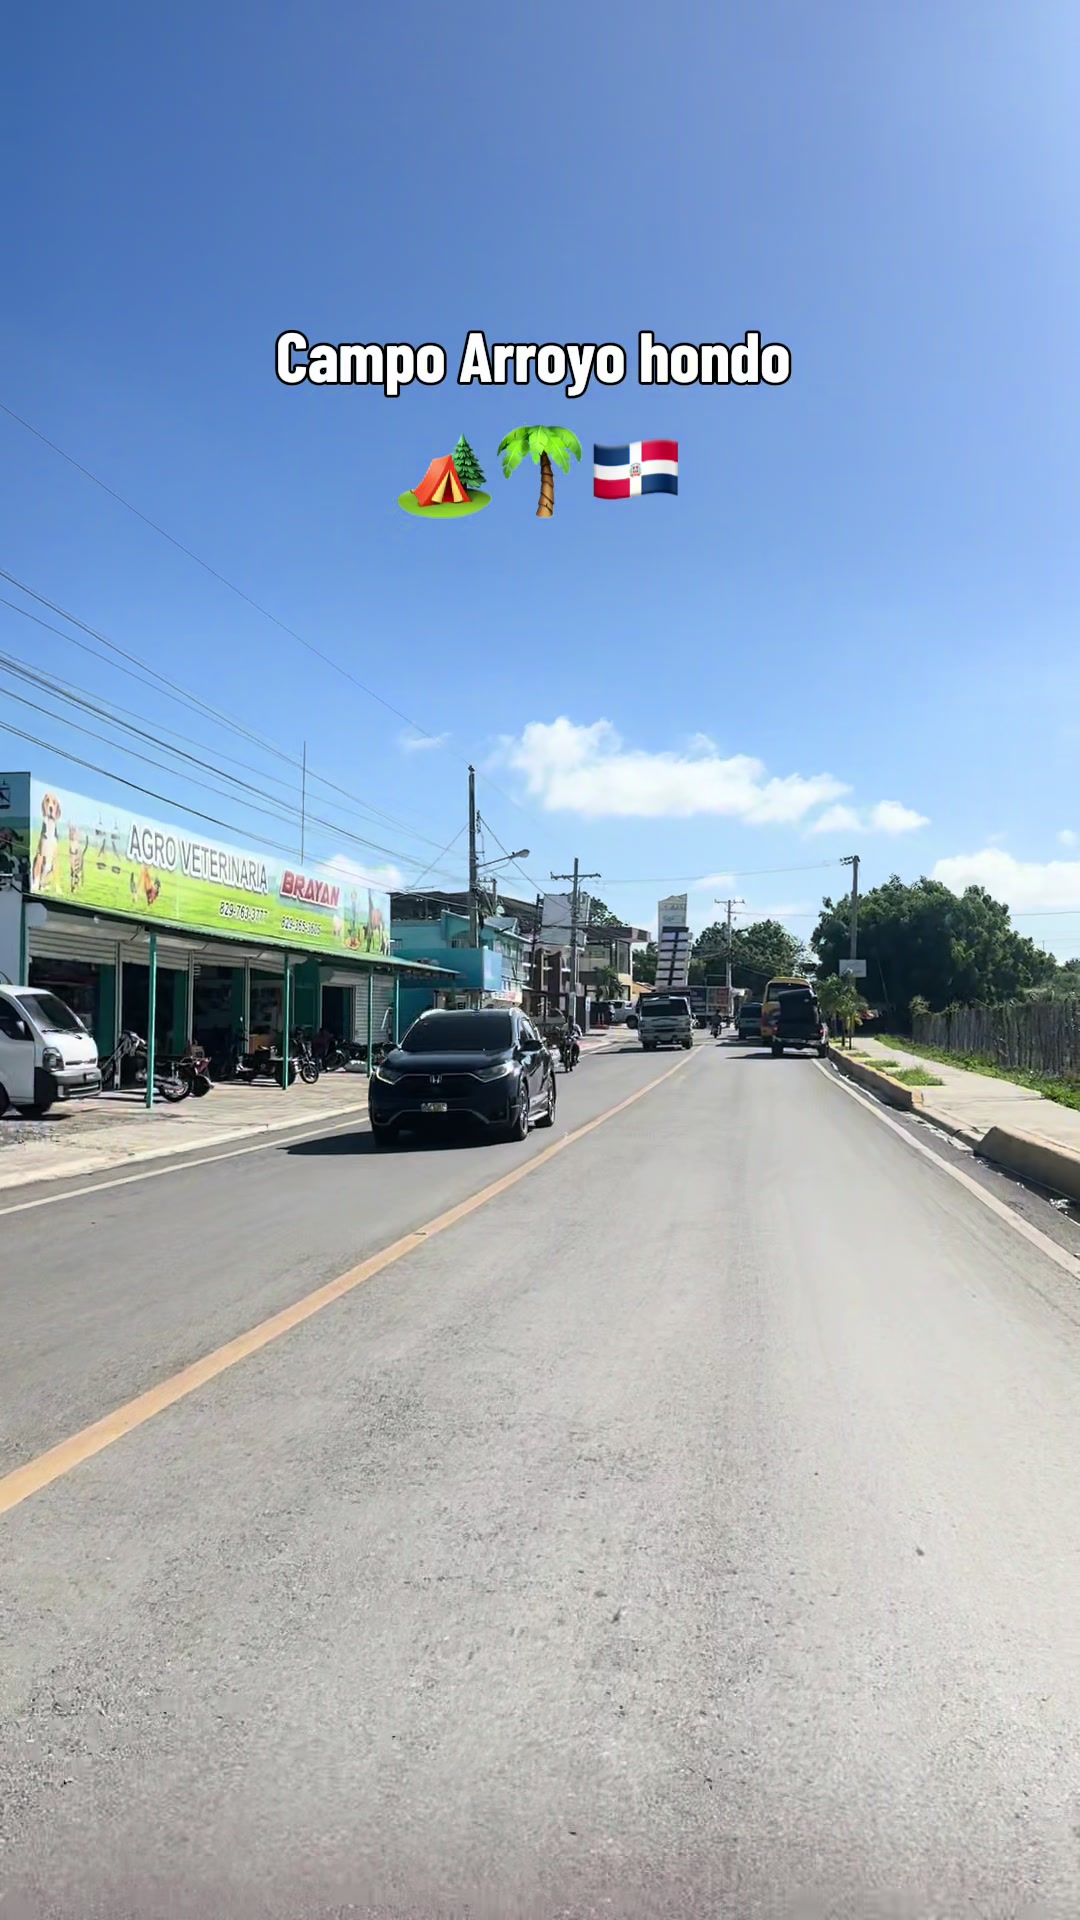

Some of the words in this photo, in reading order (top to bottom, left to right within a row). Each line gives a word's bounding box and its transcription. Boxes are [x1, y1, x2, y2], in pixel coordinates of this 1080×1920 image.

[127, 824, 176, 868] AGRO
[179, 840, 268, 892] VETERINARIA
[280, 871, 340, 906] BRAYAN
